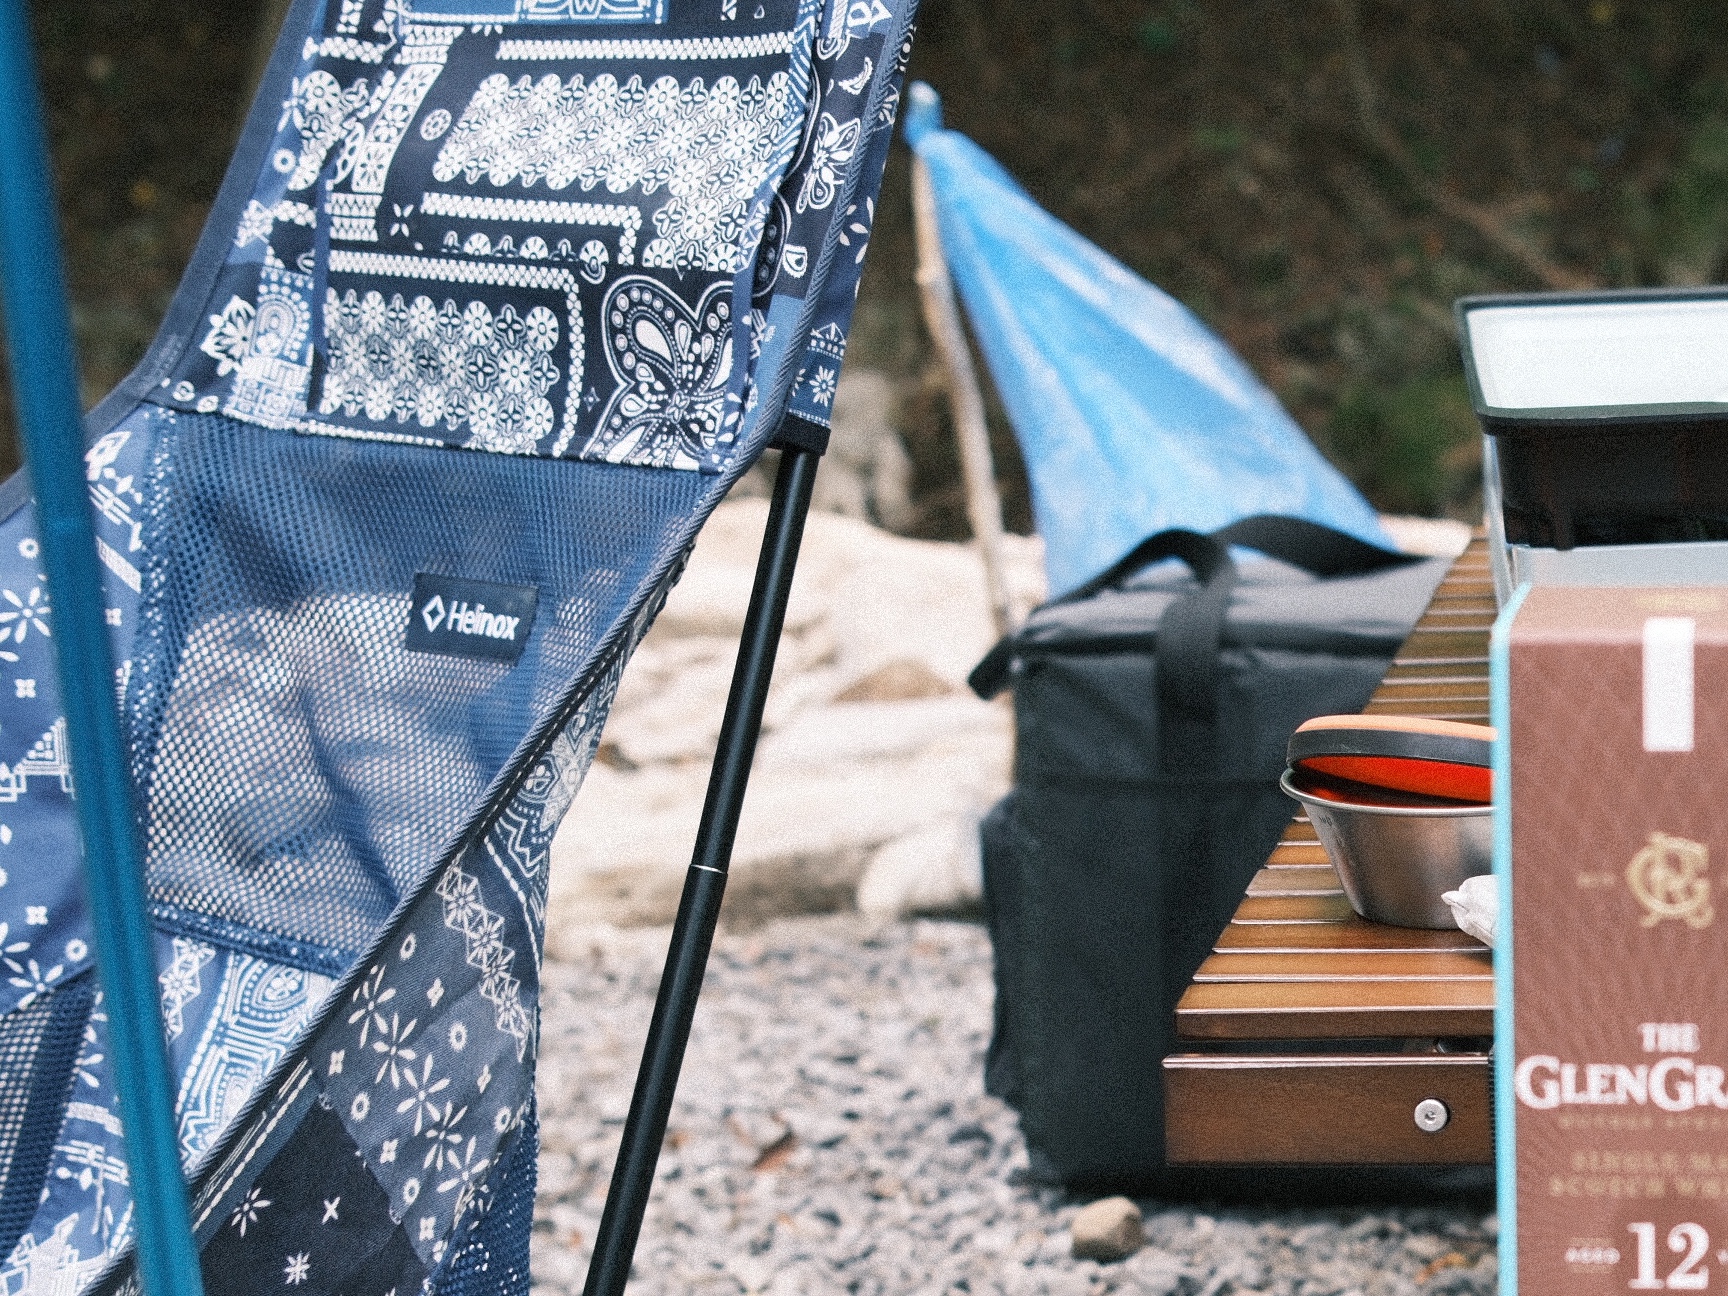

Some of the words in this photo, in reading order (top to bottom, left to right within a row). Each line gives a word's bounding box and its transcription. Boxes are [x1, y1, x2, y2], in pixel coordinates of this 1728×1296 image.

[447, 600, 520, 640] Helinox
[1639, 1022, 1700, 1053] THE
[1628, 1221, 1710, 1290] 12
